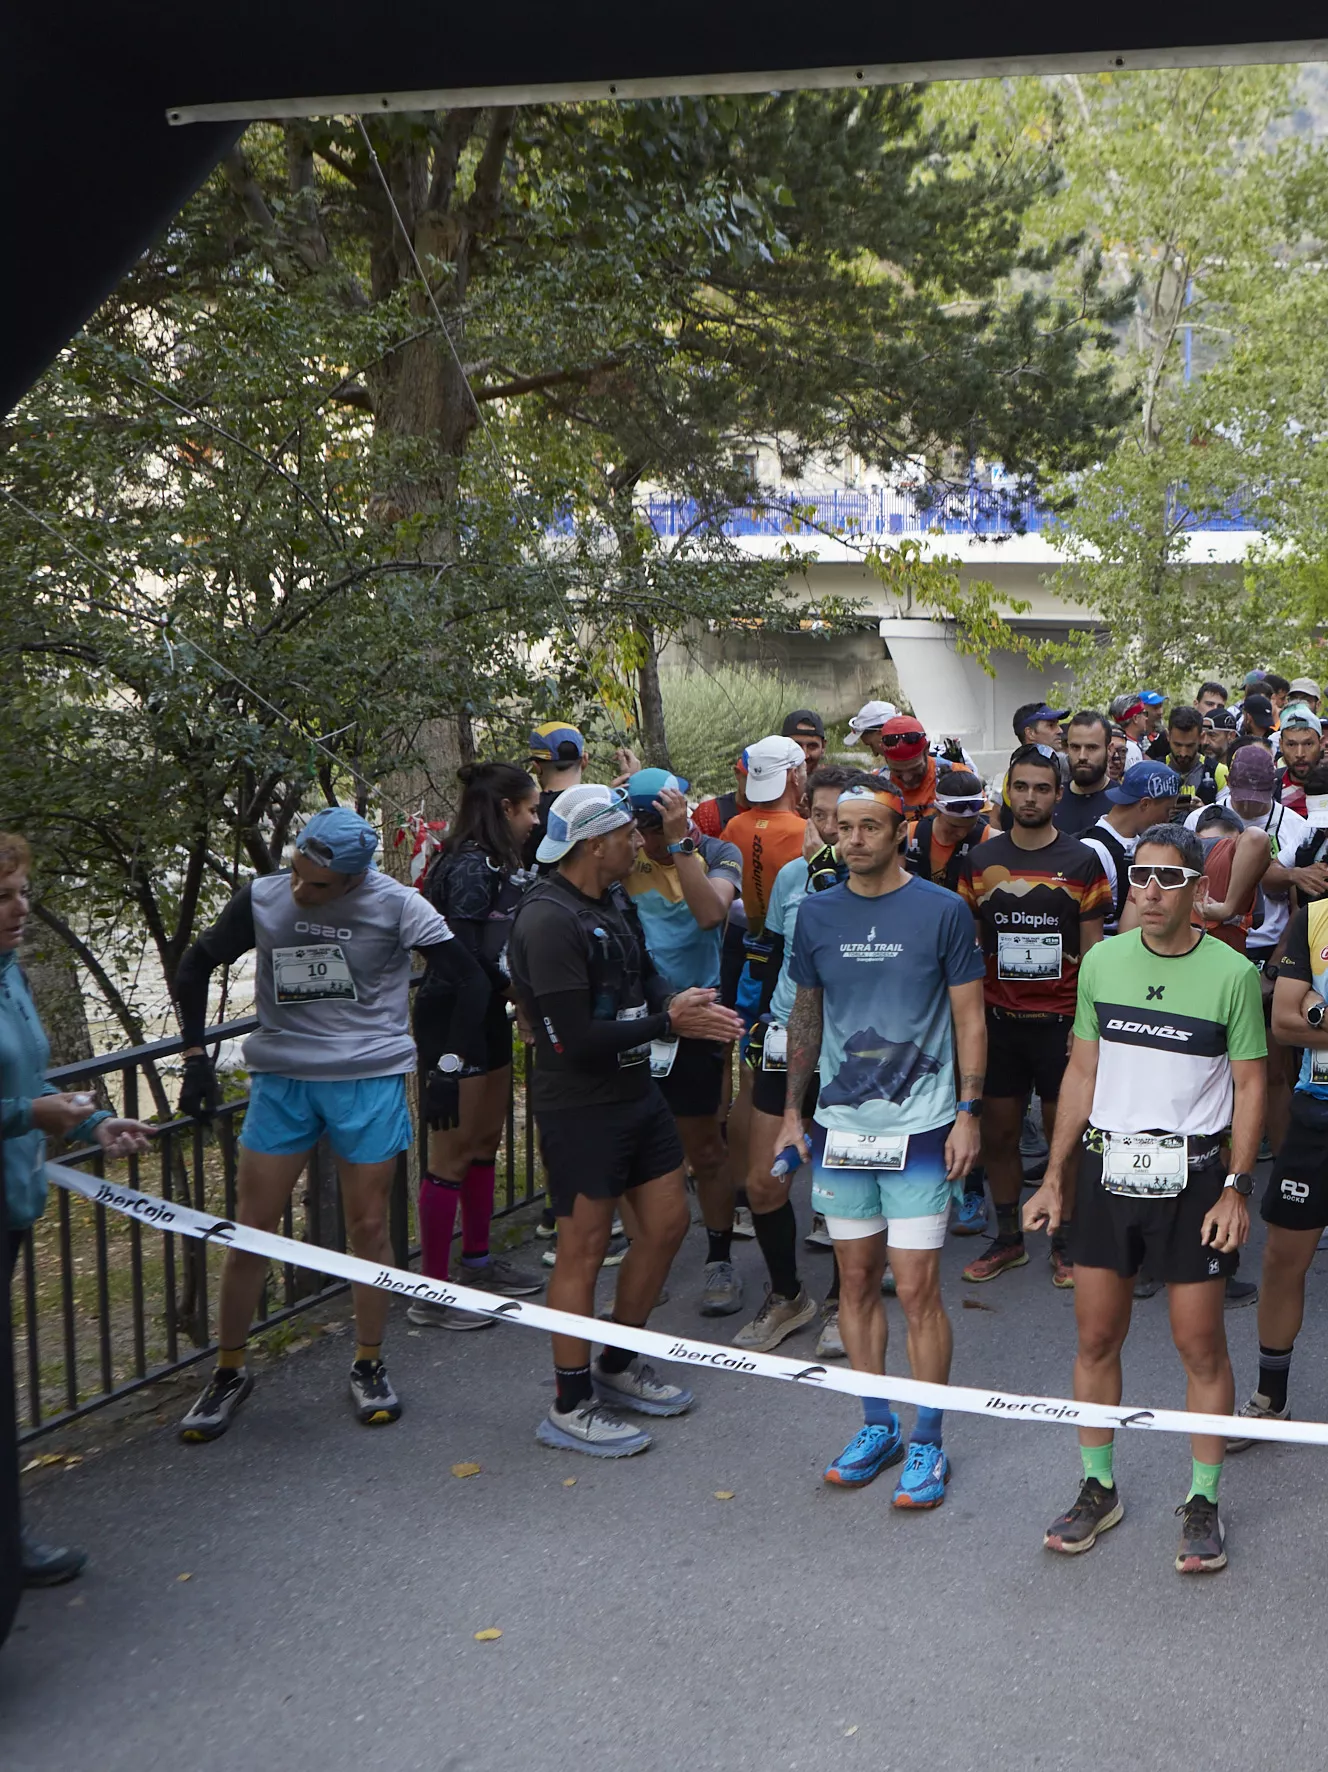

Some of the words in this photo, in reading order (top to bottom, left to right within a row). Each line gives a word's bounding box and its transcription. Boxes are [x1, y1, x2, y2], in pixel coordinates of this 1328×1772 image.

[994, 912, 1008, 924] Os
[1012, 911, 1059, 928] Diaples
[840, 943, 871, 952] ULTRA
[874, 943, 904, 952] TRAIL
[1025, 949, 1032, 960] 1
[307, 963, 327, 976] 10
[1132, 1154, 1151, 1168] 20
[95, 1184, 176, 1223] iberCaja
[1282, 1194, 1305, 1204] SOCKS
[668, 1343, 757, 1371] iberCaja
[985, 1397, 1080, 1419] iberCaja
